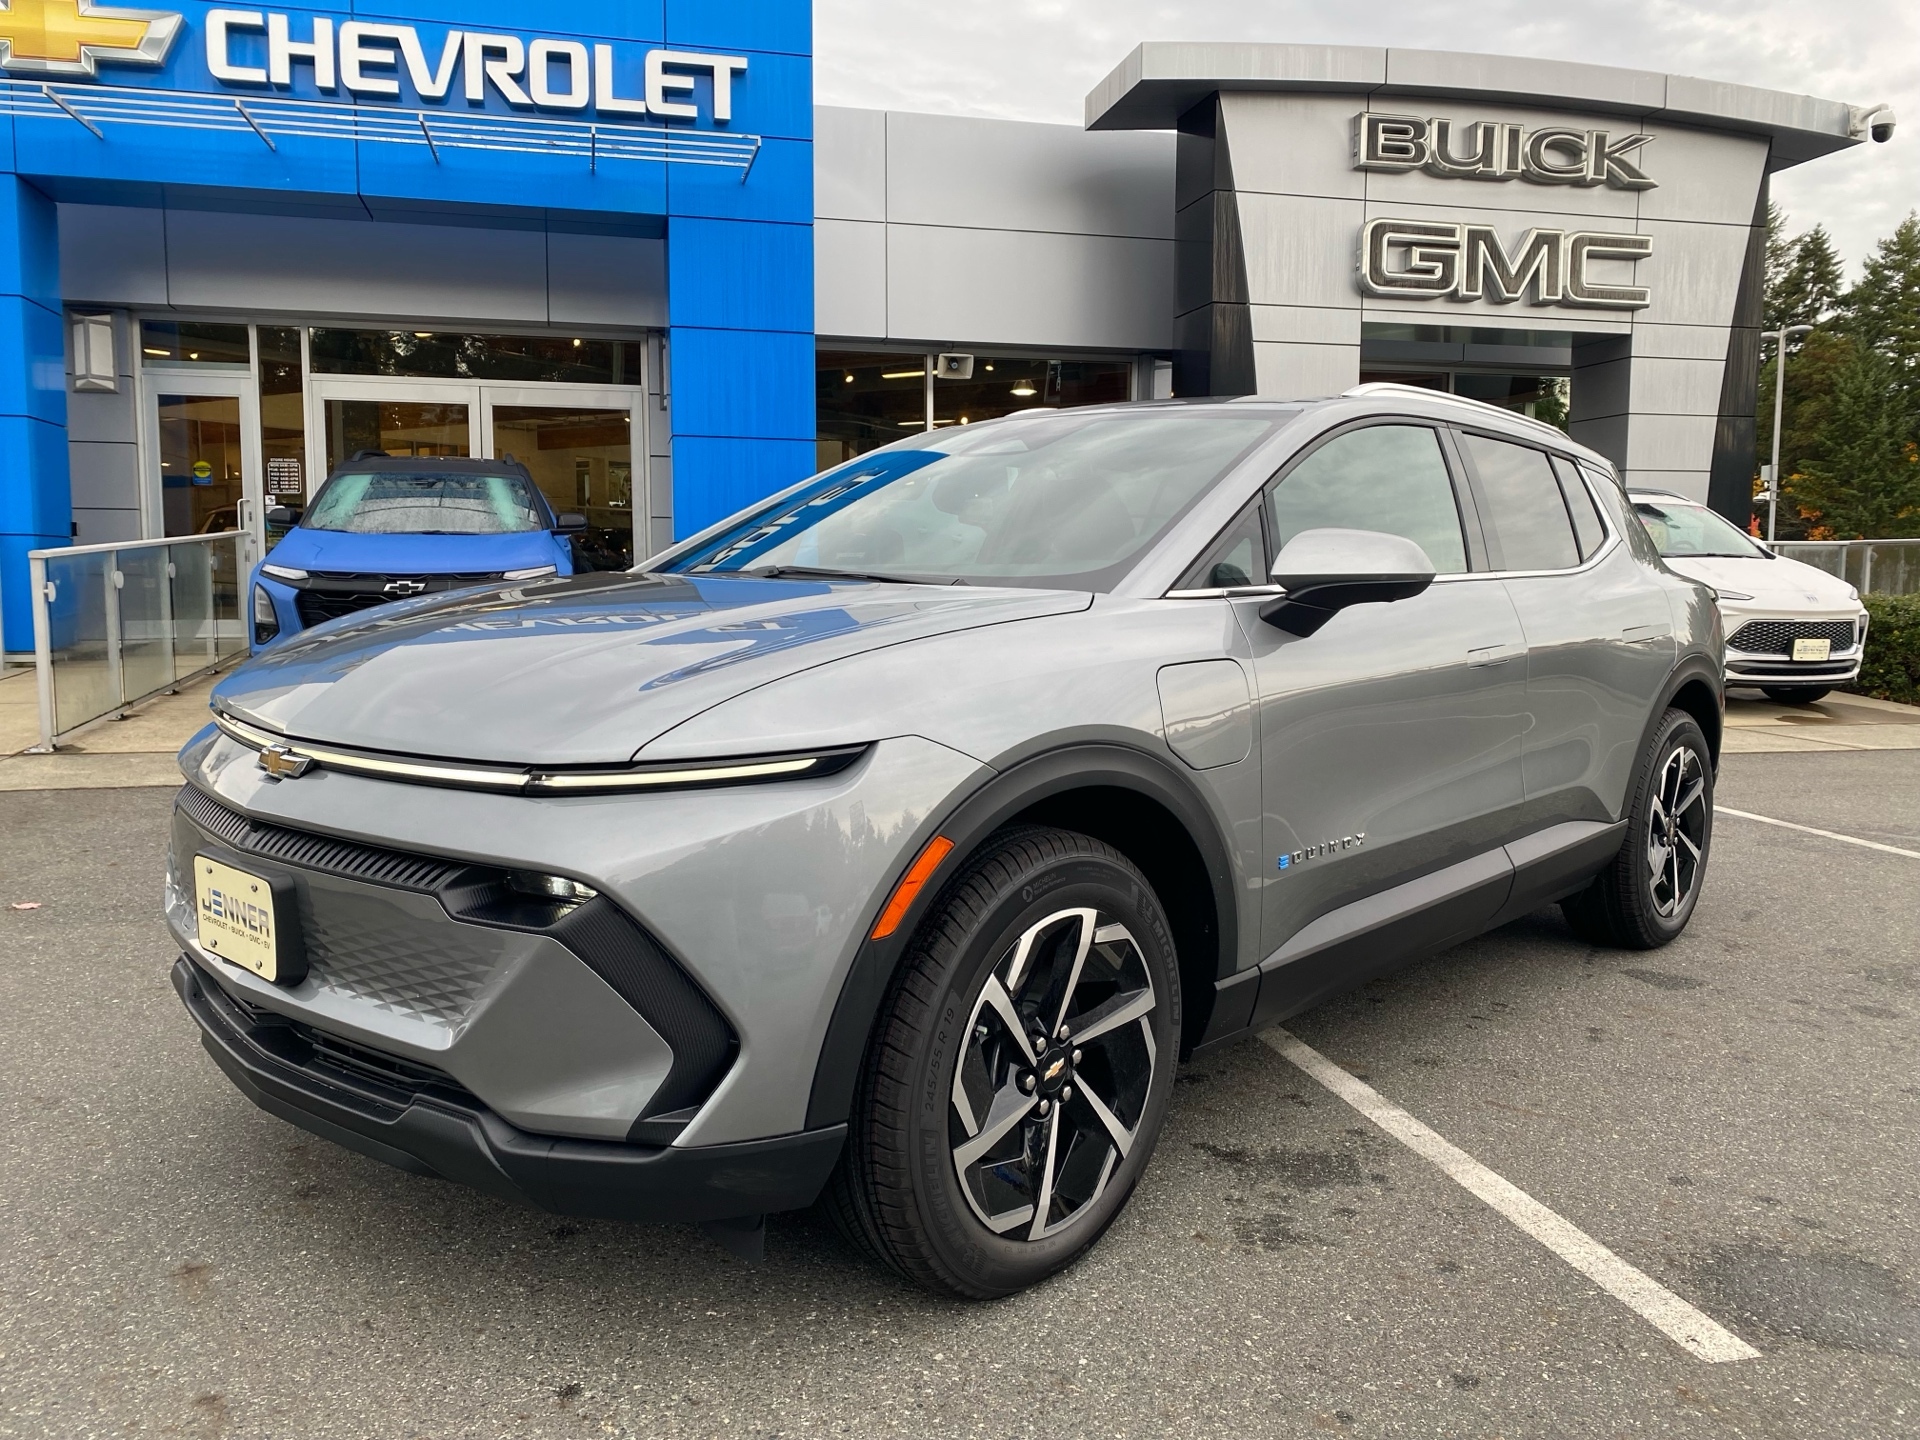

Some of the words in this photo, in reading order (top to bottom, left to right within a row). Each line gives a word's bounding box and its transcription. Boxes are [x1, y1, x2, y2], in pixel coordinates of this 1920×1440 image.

[206, 9, 748, 122] CHEVROLET
[1354, 112, 1659, 190] BUICK
[1356, 217, 1653, 309] GMC
[1278, 832, 1365, 870] EQUINOX
[202, 888, 270, 938] JENNER
[202, 913, 228, 931] CHEVROLET
[231, 927, 246, 938] BUICK
[249, 933, 261, 945] GMC
[264, 940, 271, 950] EV
[1153, 920, 1179, 1020] MICHELIN
[924, 1137, 965, 1248] MICHELIN
